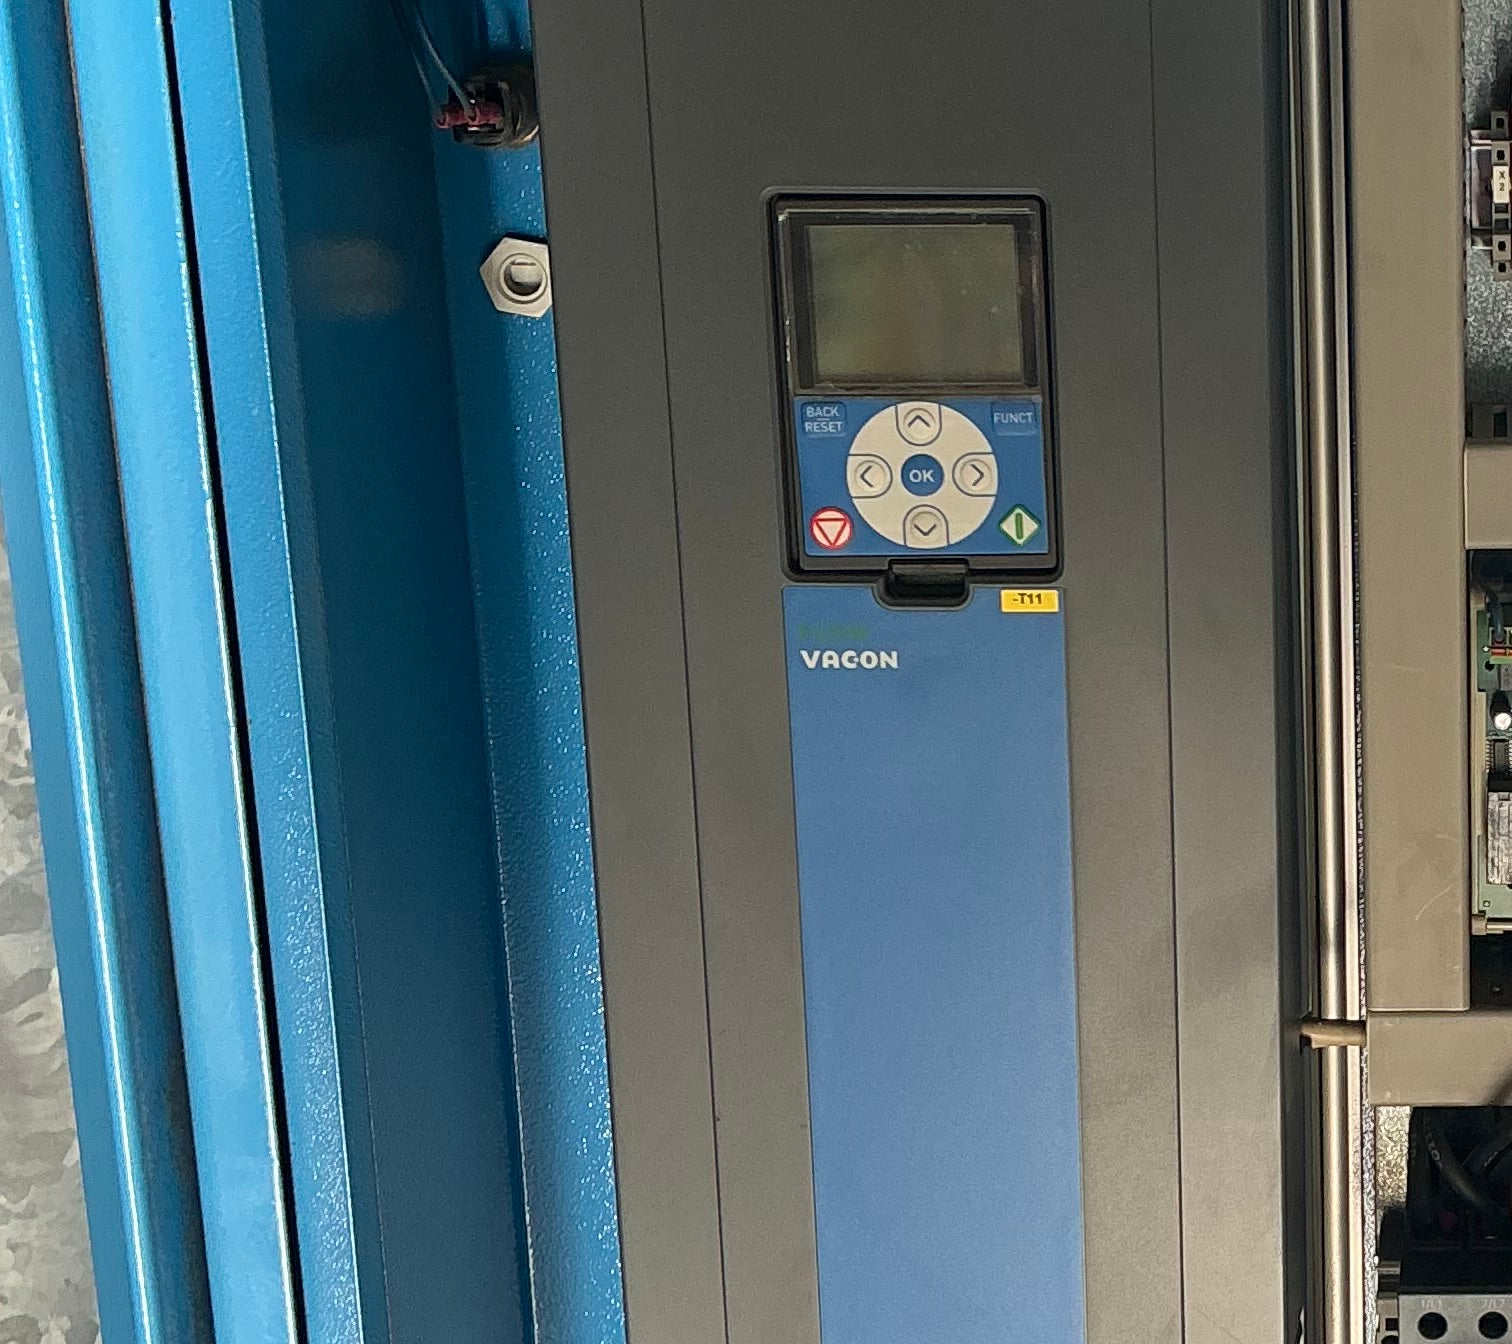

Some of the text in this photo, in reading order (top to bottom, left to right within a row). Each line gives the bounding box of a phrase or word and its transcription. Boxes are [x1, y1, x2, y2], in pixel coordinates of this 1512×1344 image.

[806, 406, 840, 417] BACK
[993, 413, 1034, 423] FUNCT
[805, 422, 843, 433] RESET
[909, 469, 935, 482] OK
[1012, 593, 1042, 605] -T11
[800, 649, 898, 669] VACON
